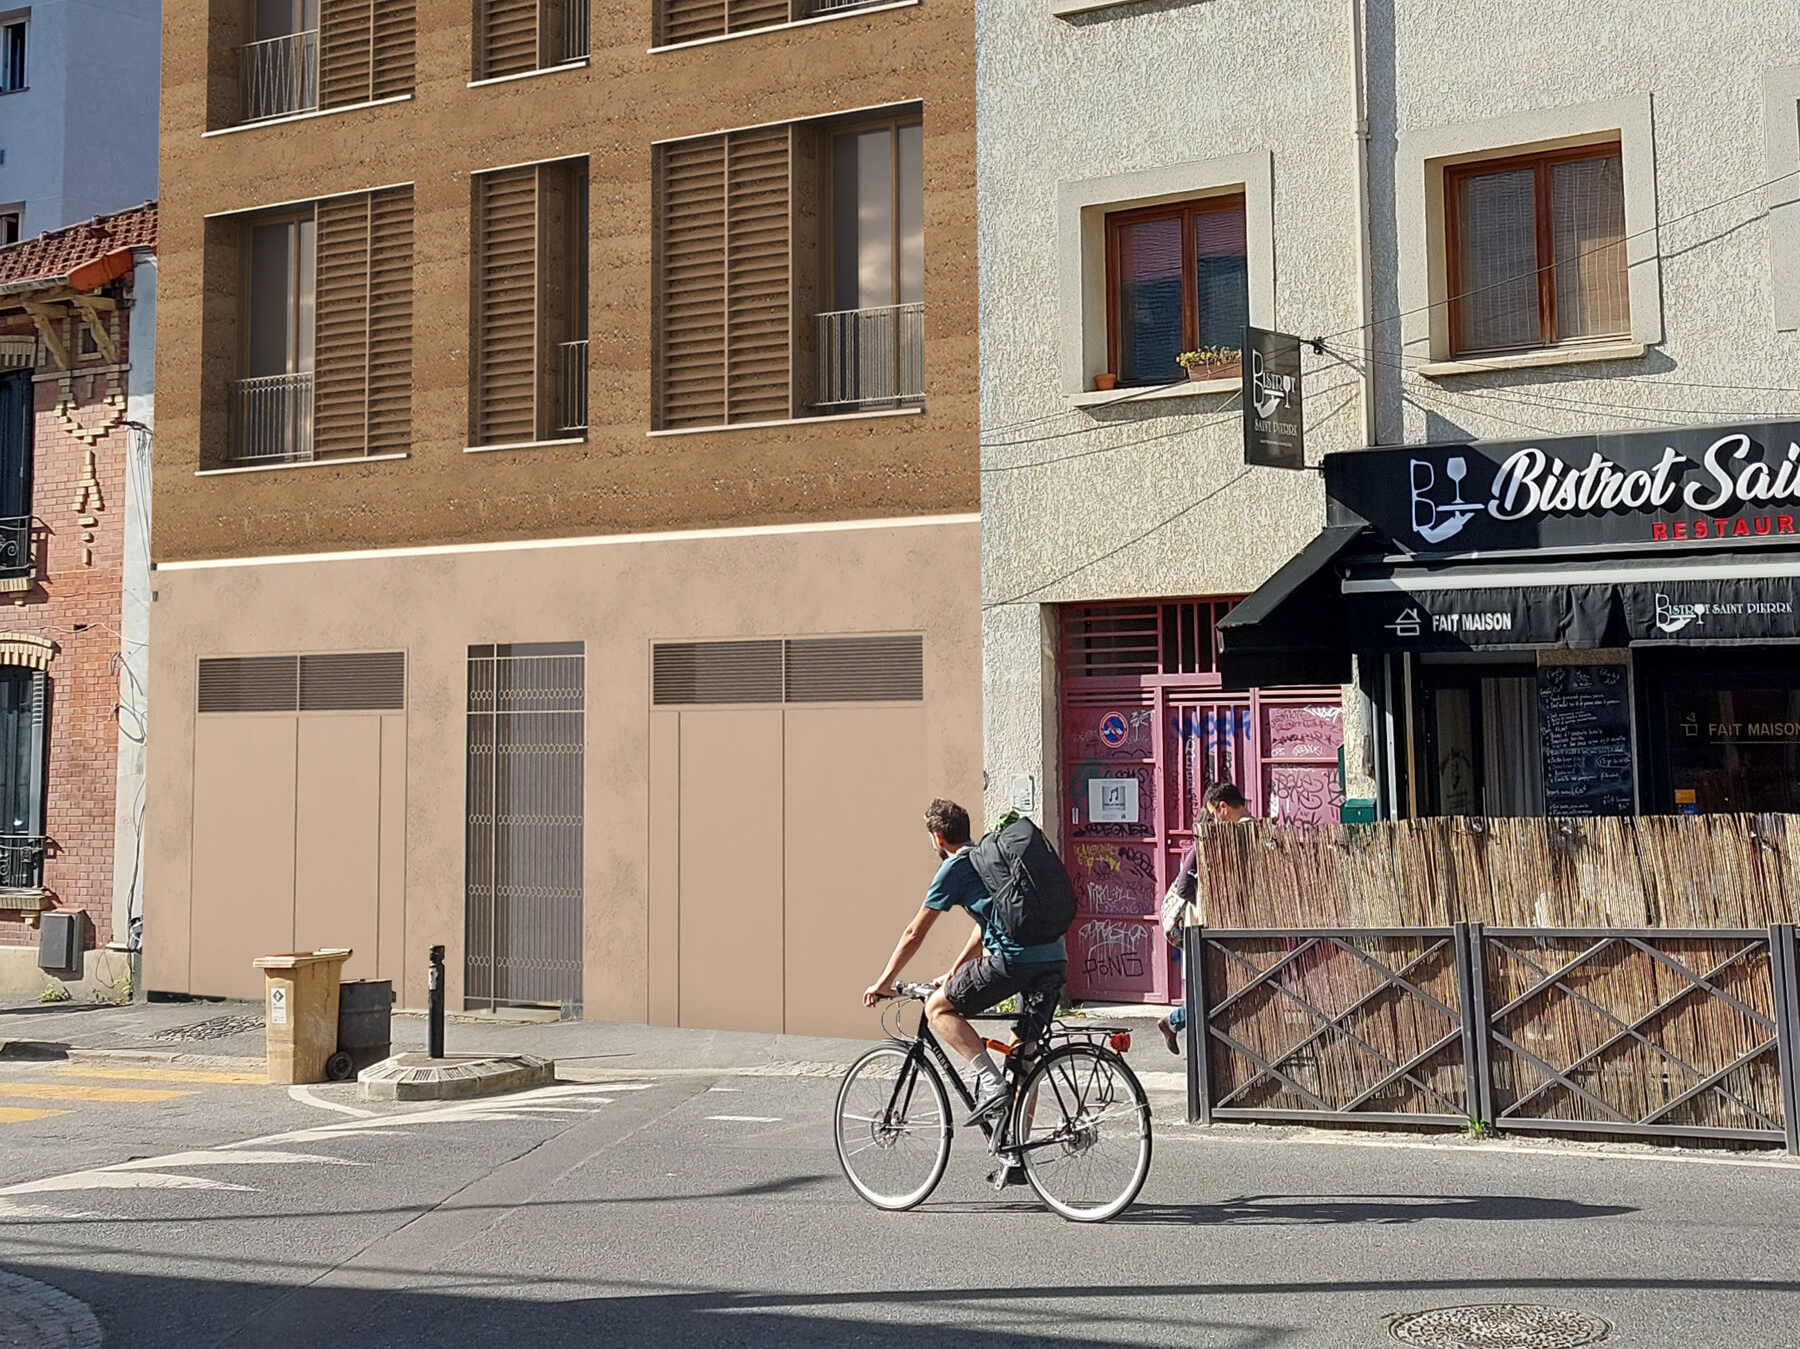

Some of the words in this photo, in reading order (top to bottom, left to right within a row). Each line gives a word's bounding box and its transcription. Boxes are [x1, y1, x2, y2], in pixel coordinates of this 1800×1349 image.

[1254, 418, 1272, 433] SAINT
[1273, 420, 1298, 437] PIERRE
[1488, 447, 1687, 521] Bistrot
[1683, 433, 1800, 511] Sai
[1652, 514, 1800, 541] RESTAUR
[1712, 603, 1744, 615] SAINT
[1747, 602, 1793, 614] PIERRE
[1432, 613, 1459, 632] FAIT
[1461, 612, 1512, 631] MAISON
[1708, 723, 1743, 737] FAIT
